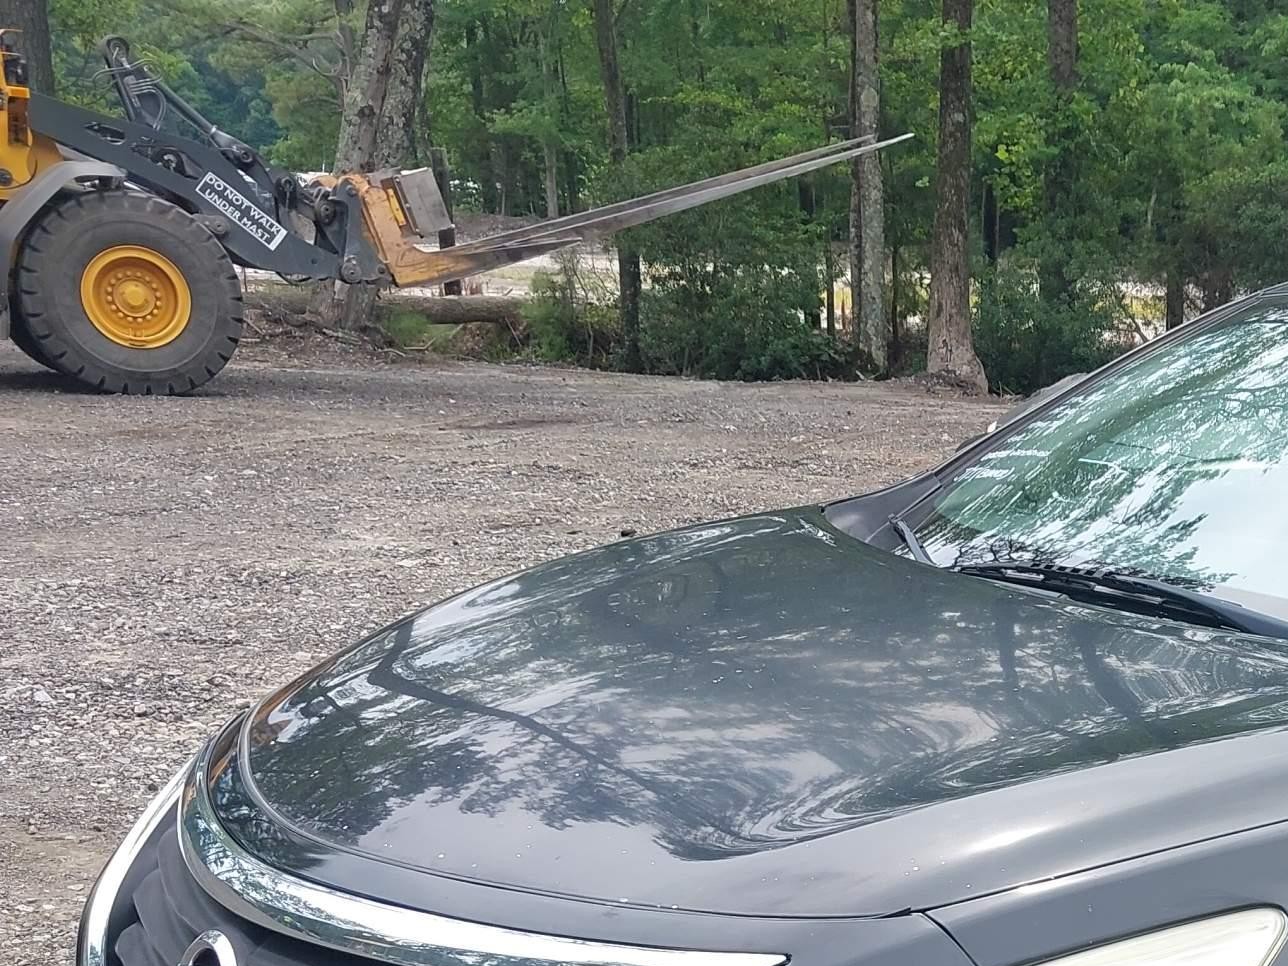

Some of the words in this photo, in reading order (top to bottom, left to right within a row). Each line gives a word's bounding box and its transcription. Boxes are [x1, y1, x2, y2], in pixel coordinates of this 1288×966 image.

[205, 189, 240, 220] UNDER
[241, 217, 270, 241] MAST
[206, 175, 224, 191] DO
[224, 189, 249, 210] NOT
[250, 207, 281, 235] WALK
